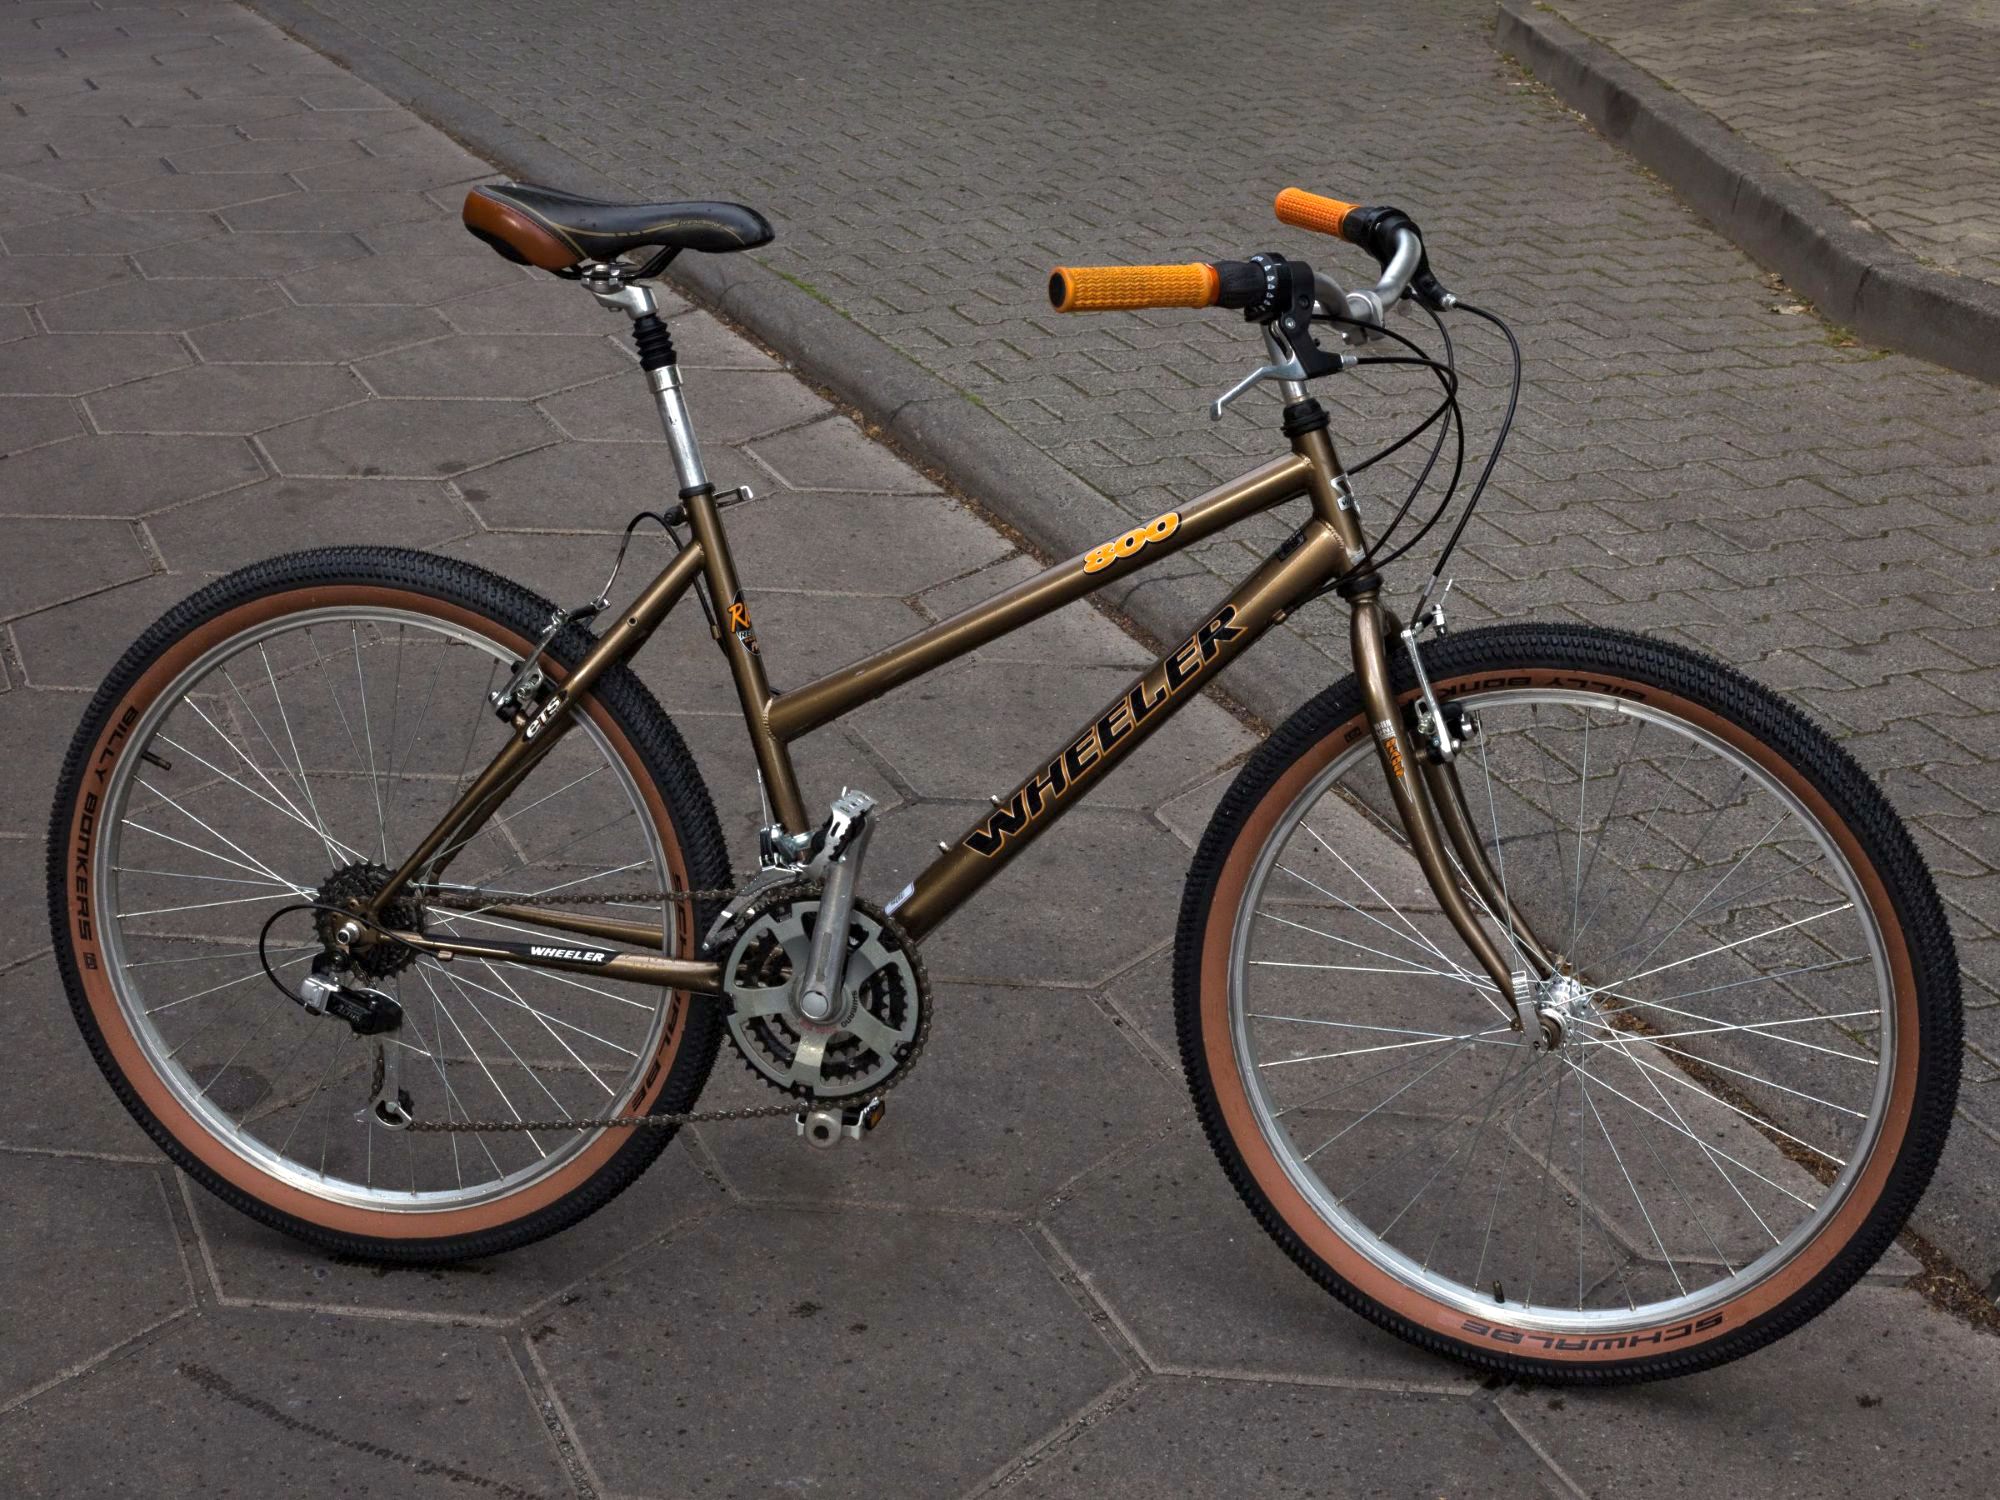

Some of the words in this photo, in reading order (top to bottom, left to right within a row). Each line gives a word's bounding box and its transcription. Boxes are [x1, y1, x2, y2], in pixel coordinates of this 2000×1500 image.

[1083, 512, 1182, 575] 800
[1436, 677, 1532, 700] BONK
[1548, 677, 1647, 701] BILLY
[95, 706, 139, 785] BILLY
[963, 604, 1248, 857] WHEELER
[75, 791, 98, 941] BONKERS
[530, 946, 605, 962] WHEELER
[840, 990, 858, 1028] SHIMANO
[1461, 1312, 1724, 1351] SCHWALBE
